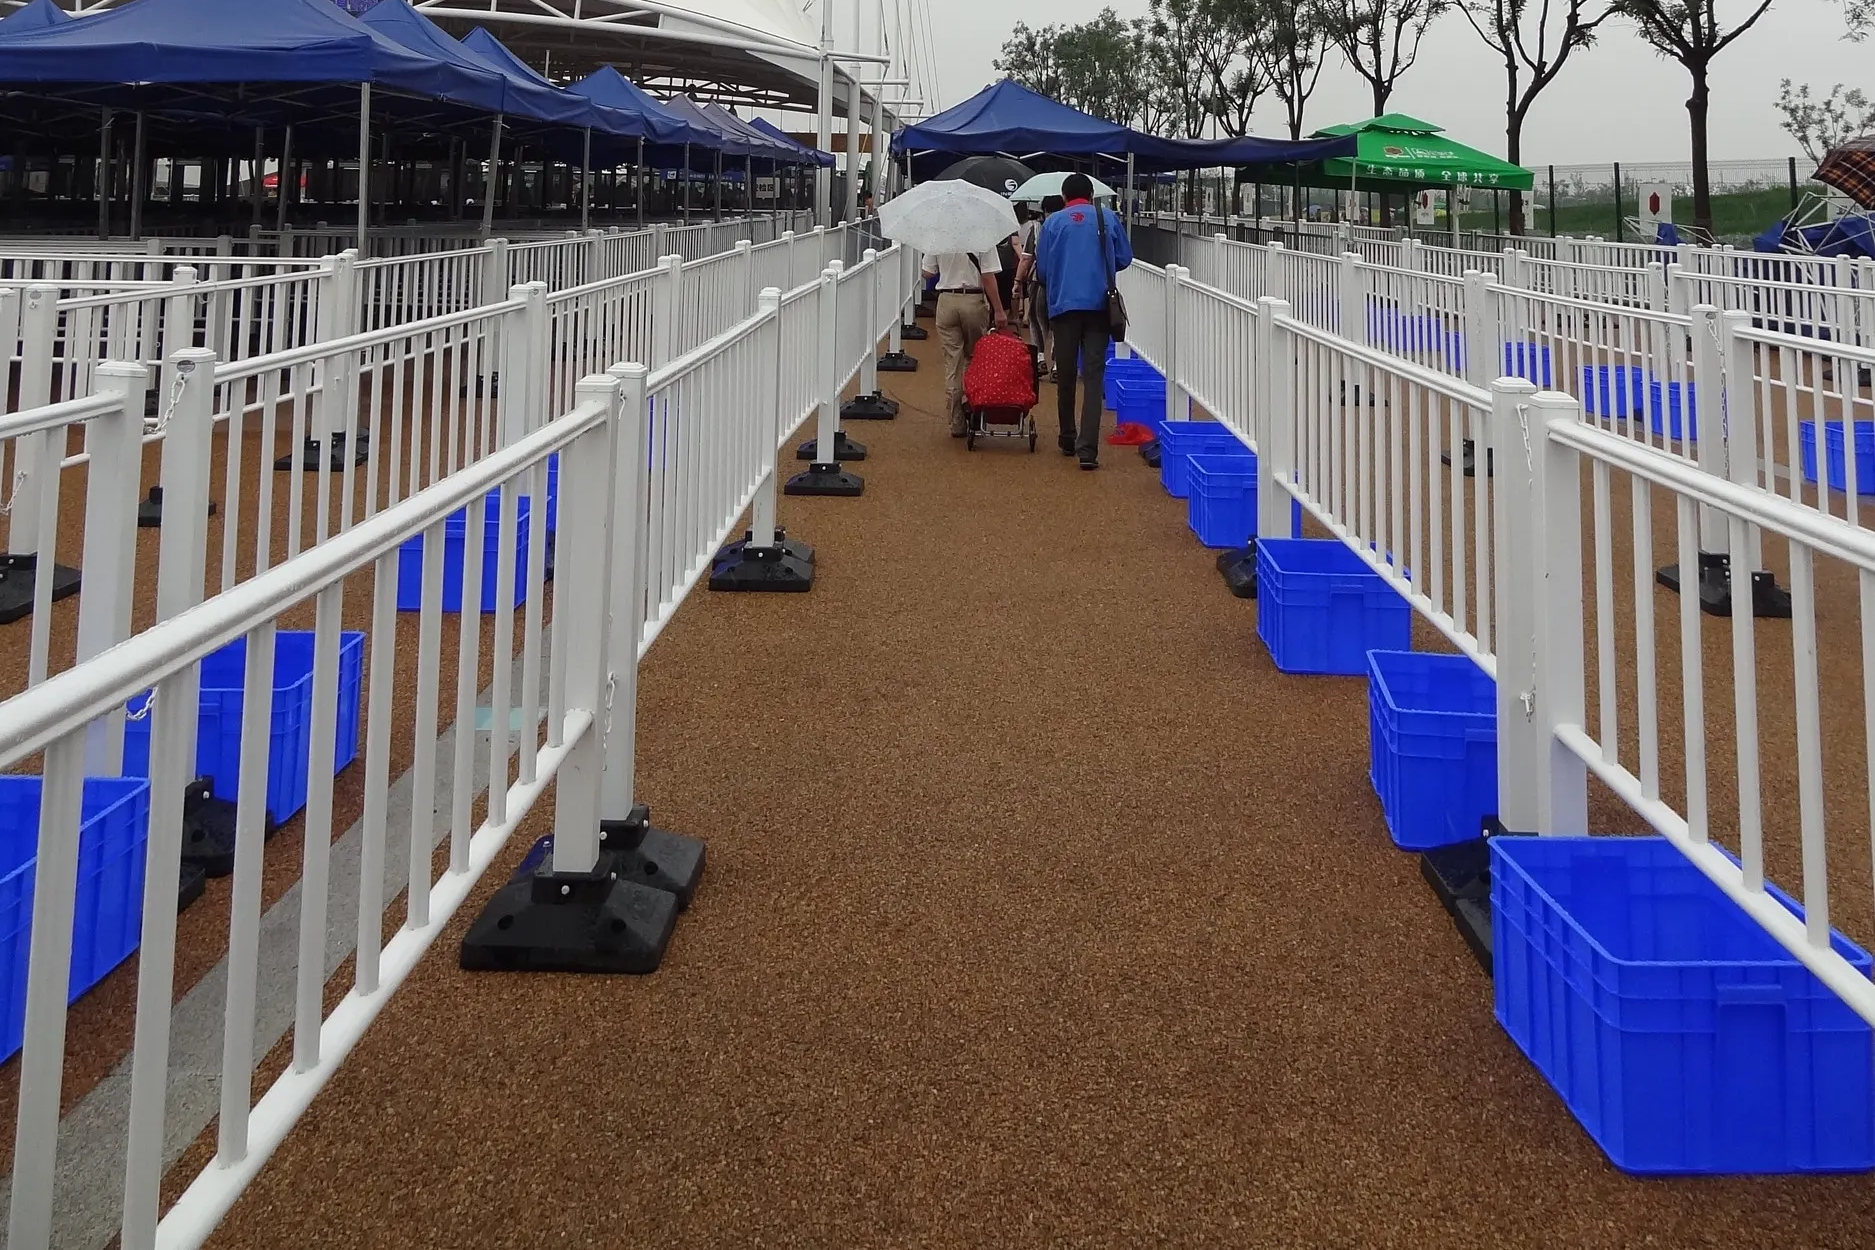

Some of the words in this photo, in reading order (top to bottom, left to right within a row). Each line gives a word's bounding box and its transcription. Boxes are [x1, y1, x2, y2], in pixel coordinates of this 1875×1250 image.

[1367, 164, 1425, 179] 生态品质
[1441, 170, 1499, 184] 全球共享
